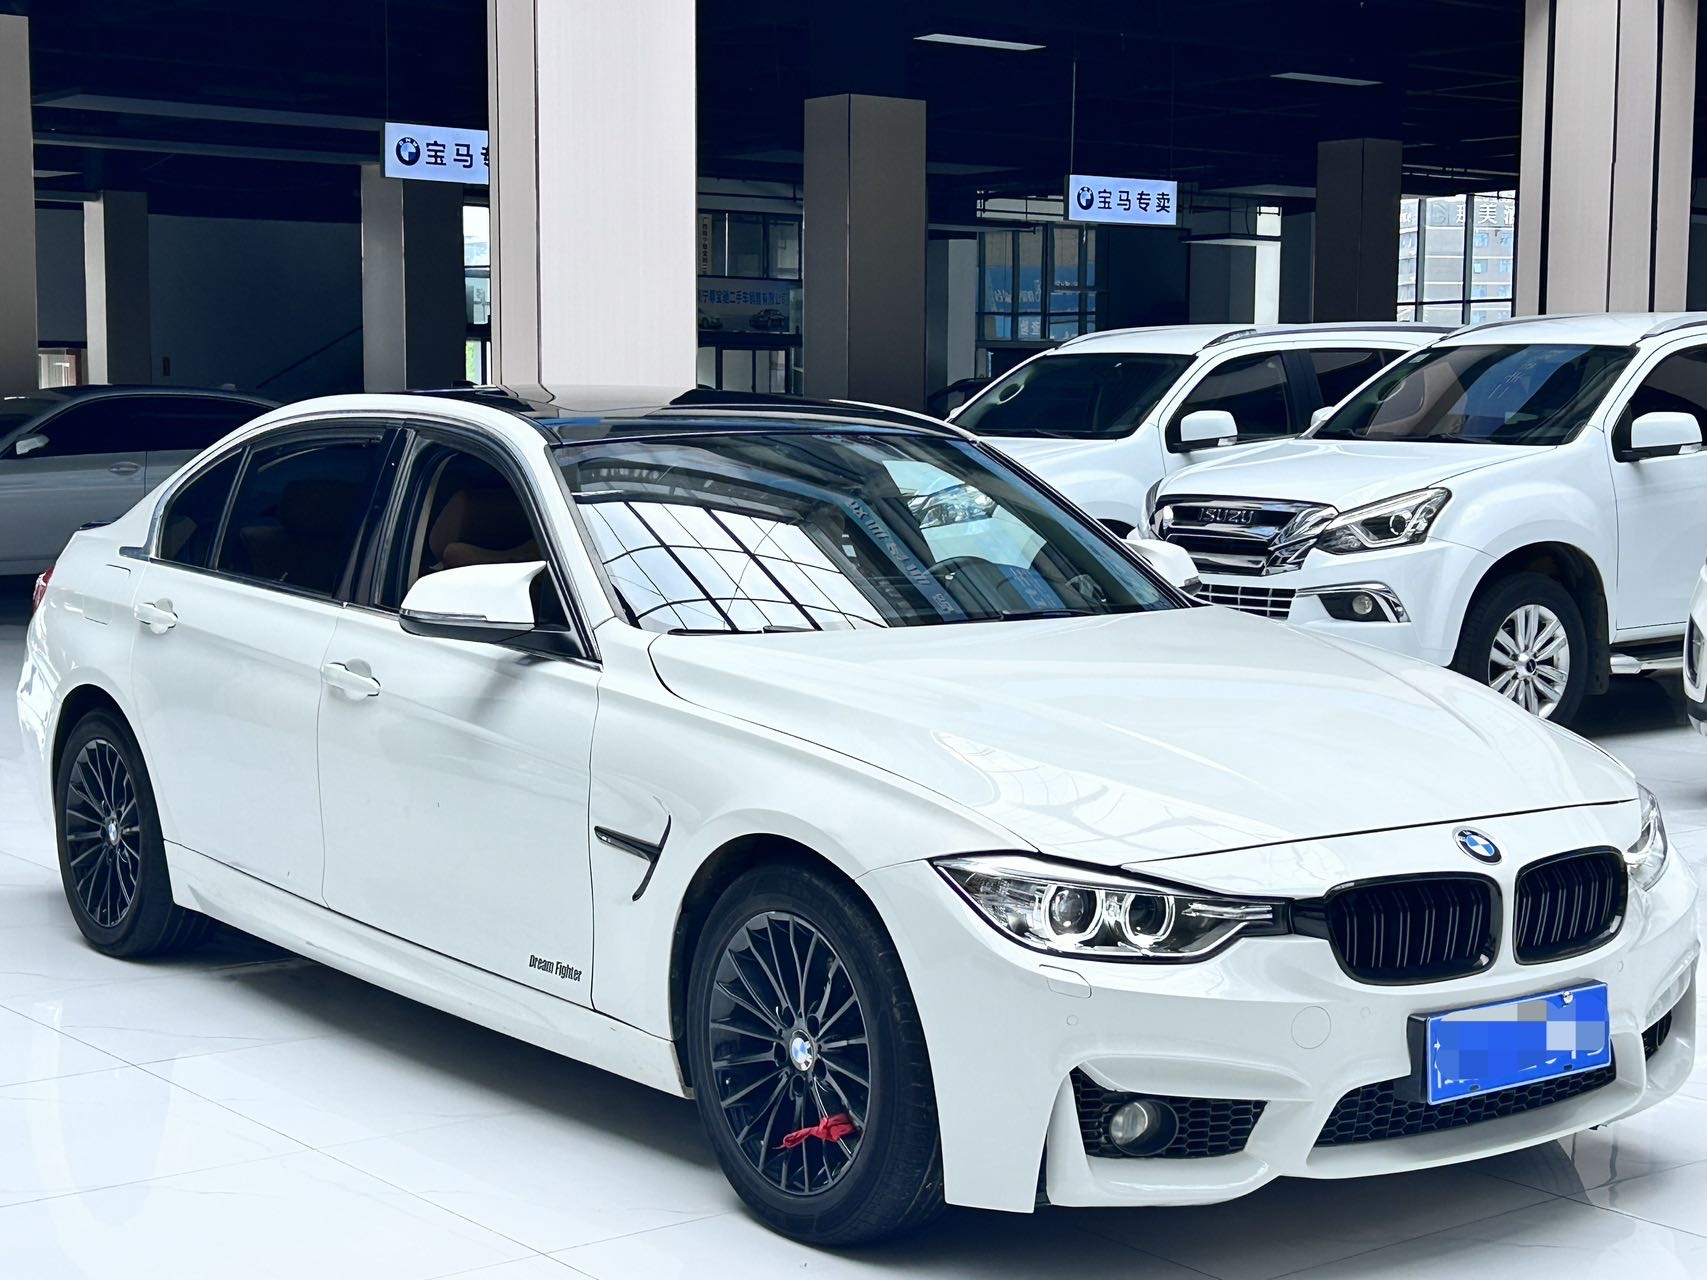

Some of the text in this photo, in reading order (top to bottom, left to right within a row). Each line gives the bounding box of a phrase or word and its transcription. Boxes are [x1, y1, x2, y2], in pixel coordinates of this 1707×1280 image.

[1097, 188, 1171, 214] 宝马专卖
[1200, 507, 1255, 524] ISUZU
[528, 954, 583, 982] Dream Fighter
